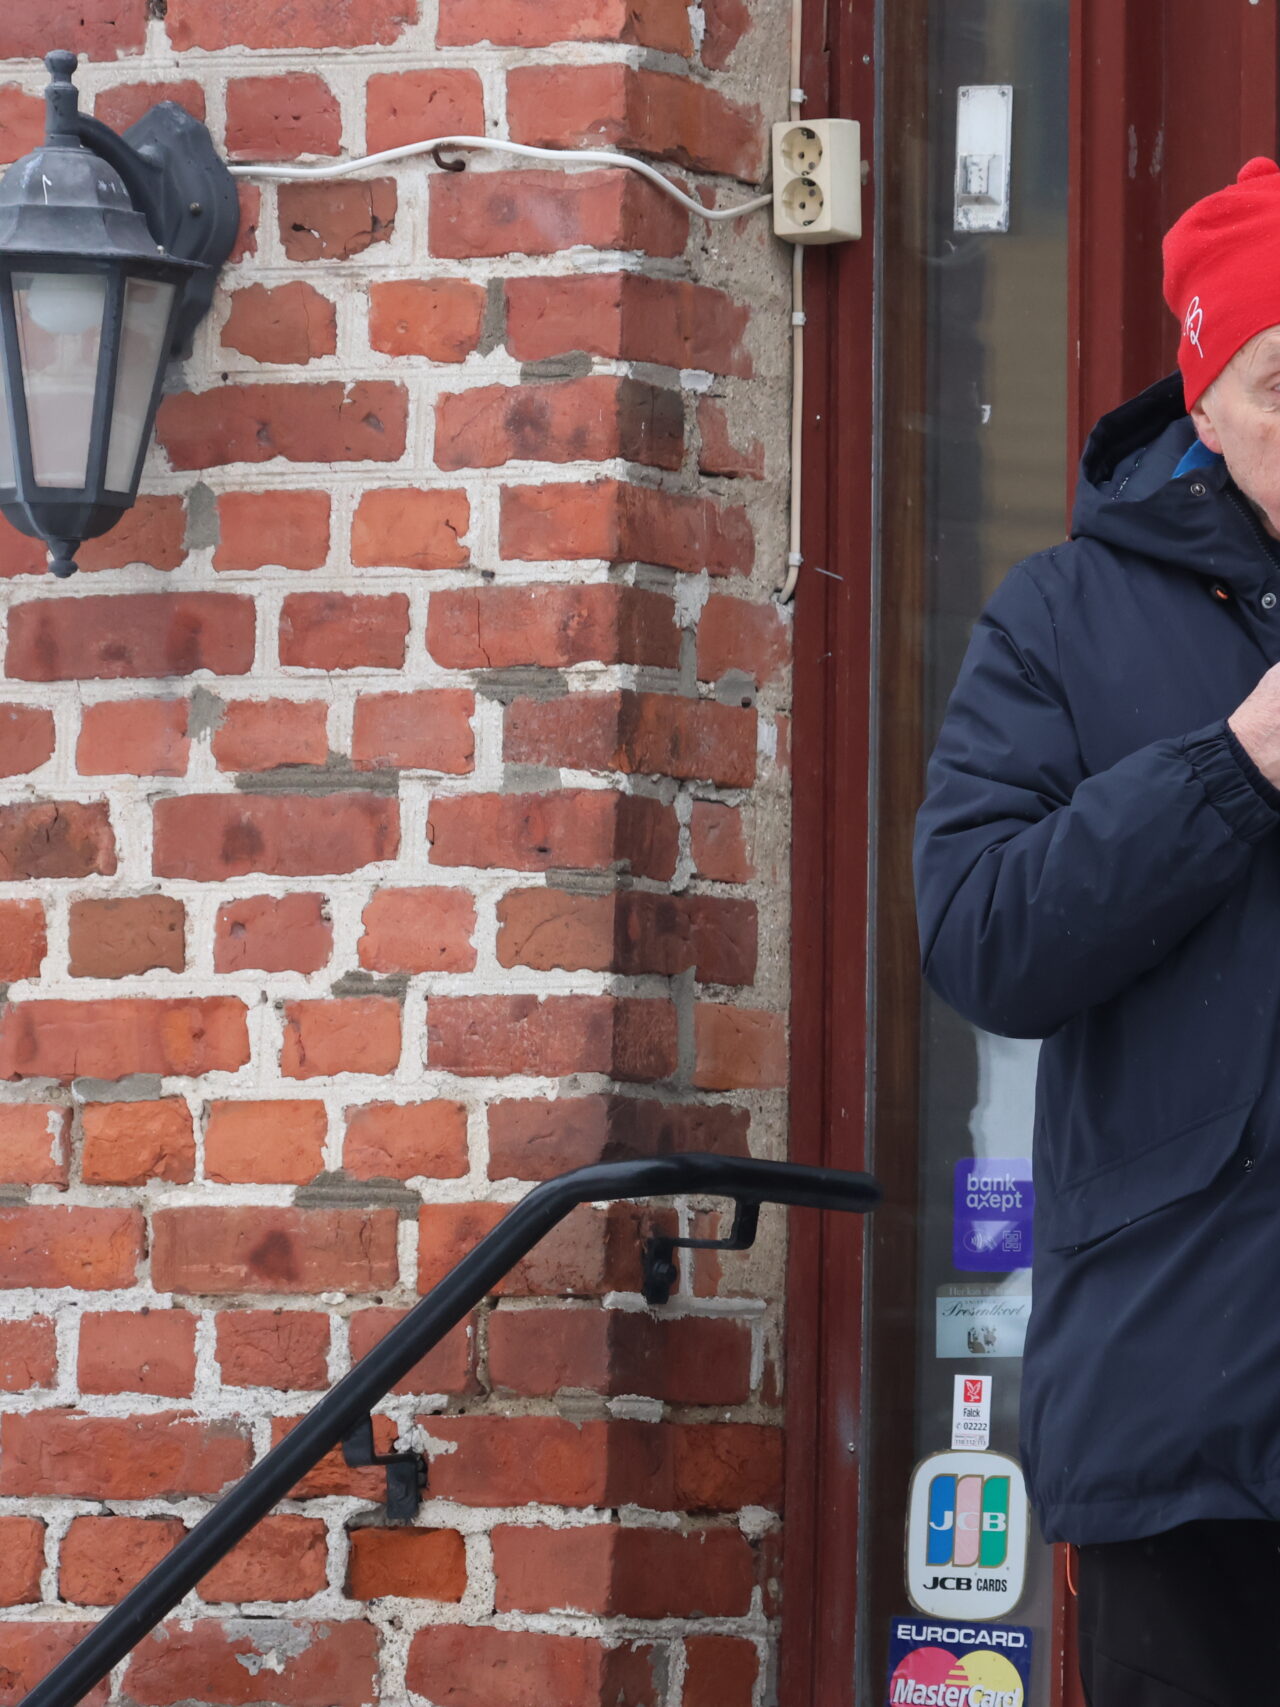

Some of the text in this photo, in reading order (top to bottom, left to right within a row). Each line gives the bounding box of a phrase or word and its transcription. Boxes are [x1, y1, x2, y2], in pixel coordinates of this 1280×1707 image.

[967, 1173, 1016, 1192] bank
[966, 1191, 1023, 1212] axept
[963, 1408, 981, 1417] Falck
[963, 1422, 988, 1431] 02222
[929, 1510, 1007, 1532] JCB
[923, 1576, 1008, 1592] JCB CARDS
[892, 1678, 1021, 1707] MasterCard
